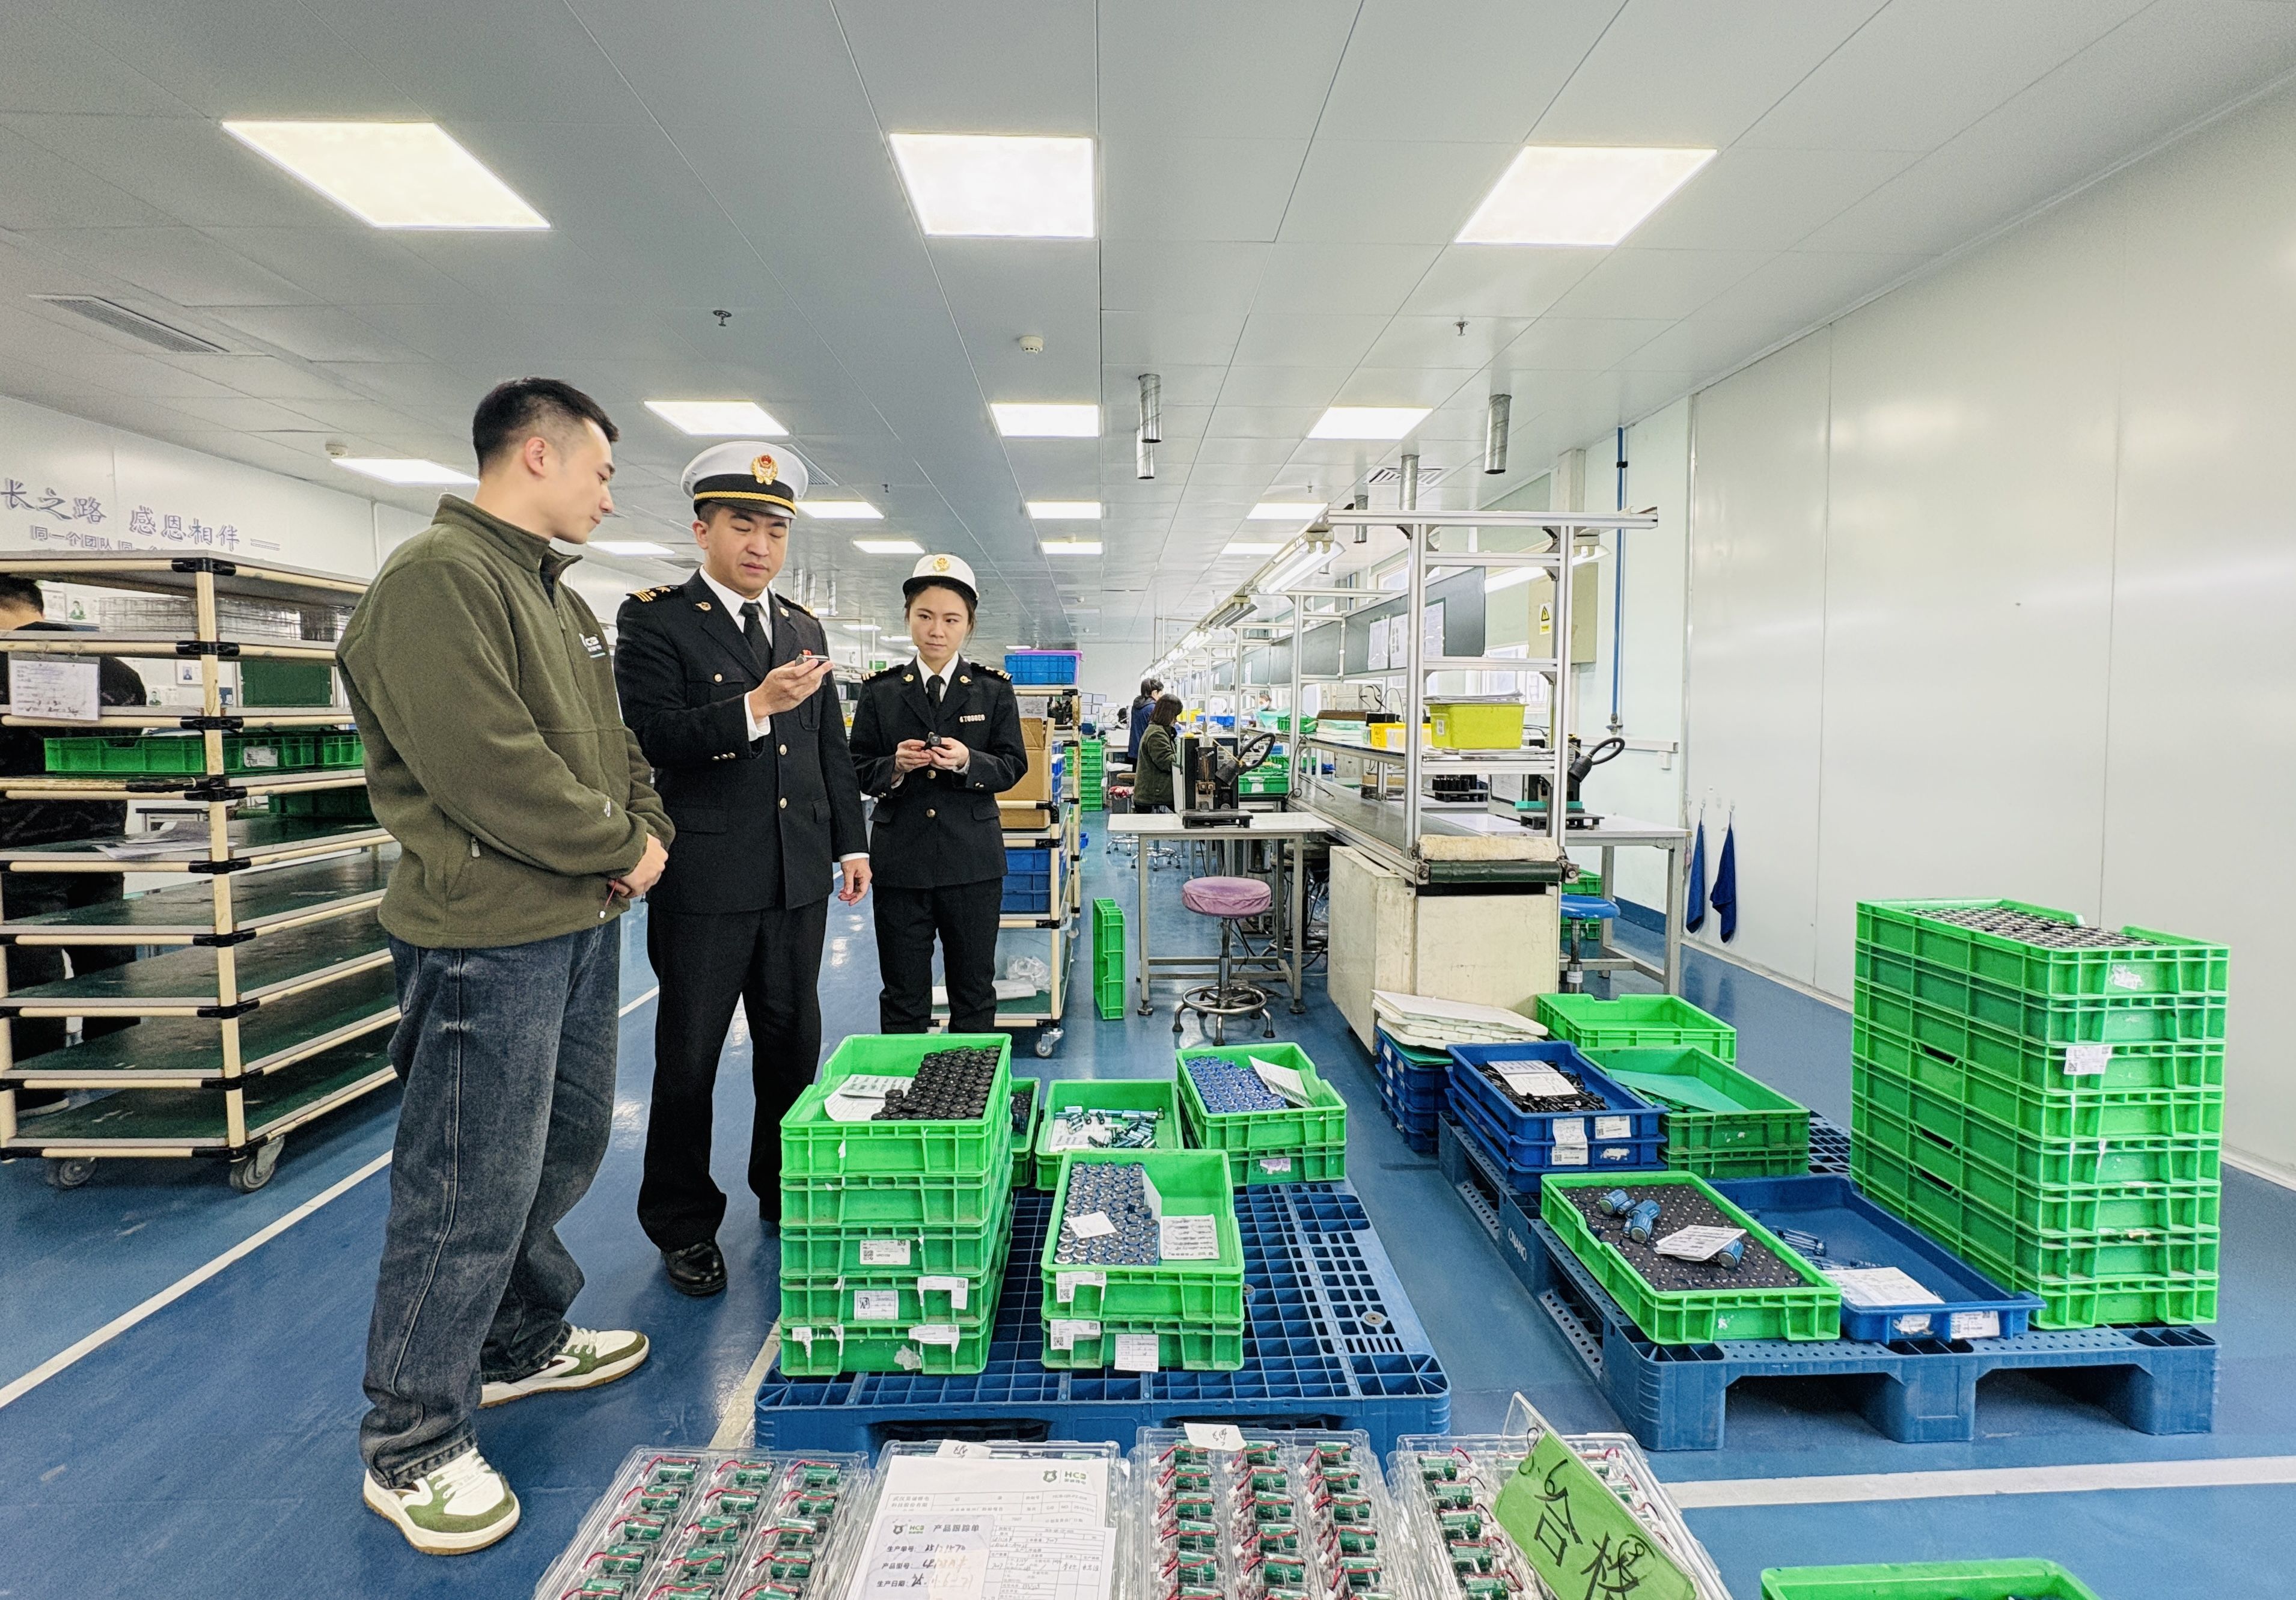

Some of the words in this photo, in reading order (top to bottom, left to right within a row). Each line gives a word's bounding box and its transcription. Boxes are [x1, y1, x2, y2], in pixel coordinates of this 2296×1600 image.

[1, 479, 107, 524] 长之路
[130, 505, 240, 551] 感恩相伴
[31, 525, 113, 551] 同一个团队
[933, 1524, 980, 1533] 产品跟踪单
